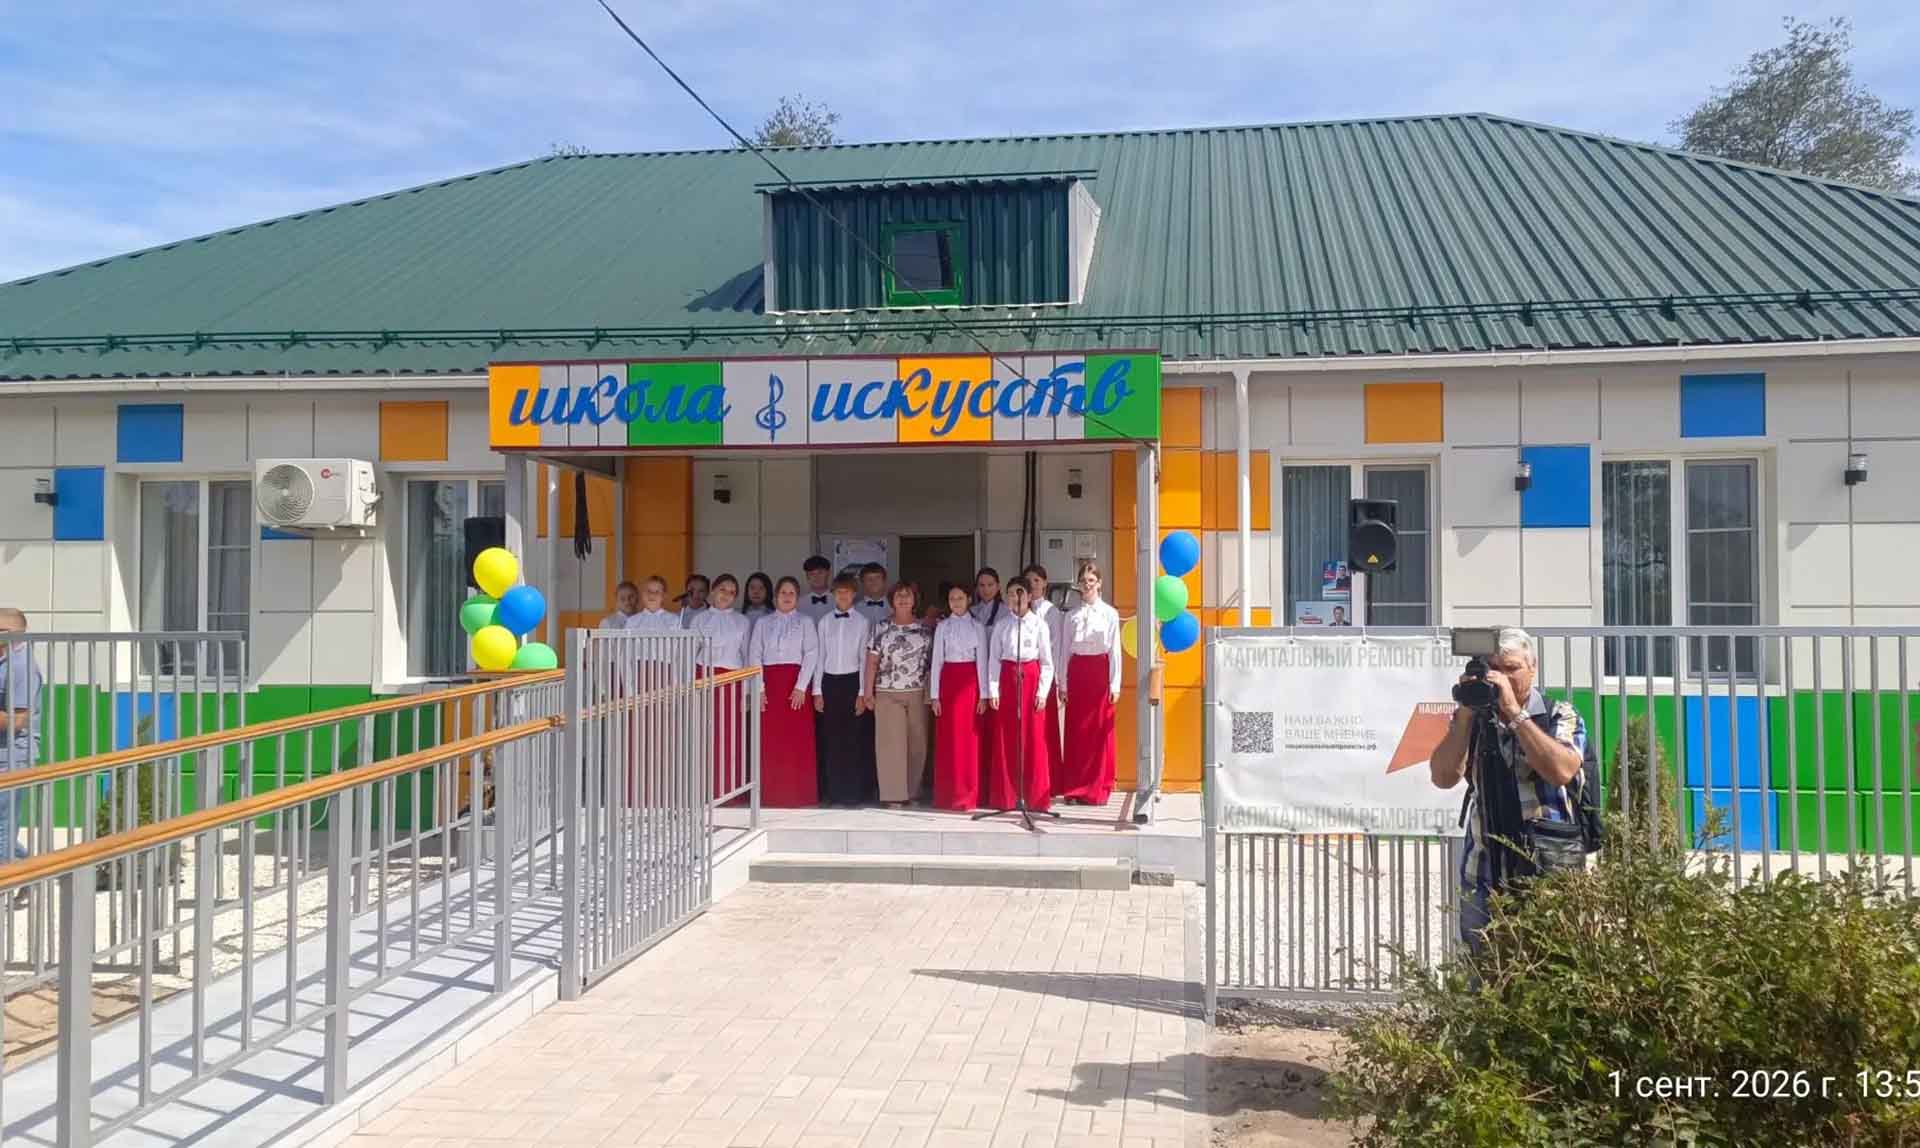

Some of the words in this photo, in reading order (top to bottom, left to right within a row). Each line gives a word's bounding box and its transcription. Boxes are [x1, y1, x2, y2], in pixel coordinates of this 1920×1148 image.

[509, 375, 732, 426] школа
[811, 359, 1134, 436] искусств
[1223, 644, 1352, 668] КАПИТАЛЬНЫЙ
[1356, 647, 1424, 668] РЕМОНТ
[1284, 714, 1312, 726] НАМ
[1284, 728, 1320, 740] ВАШЕ
